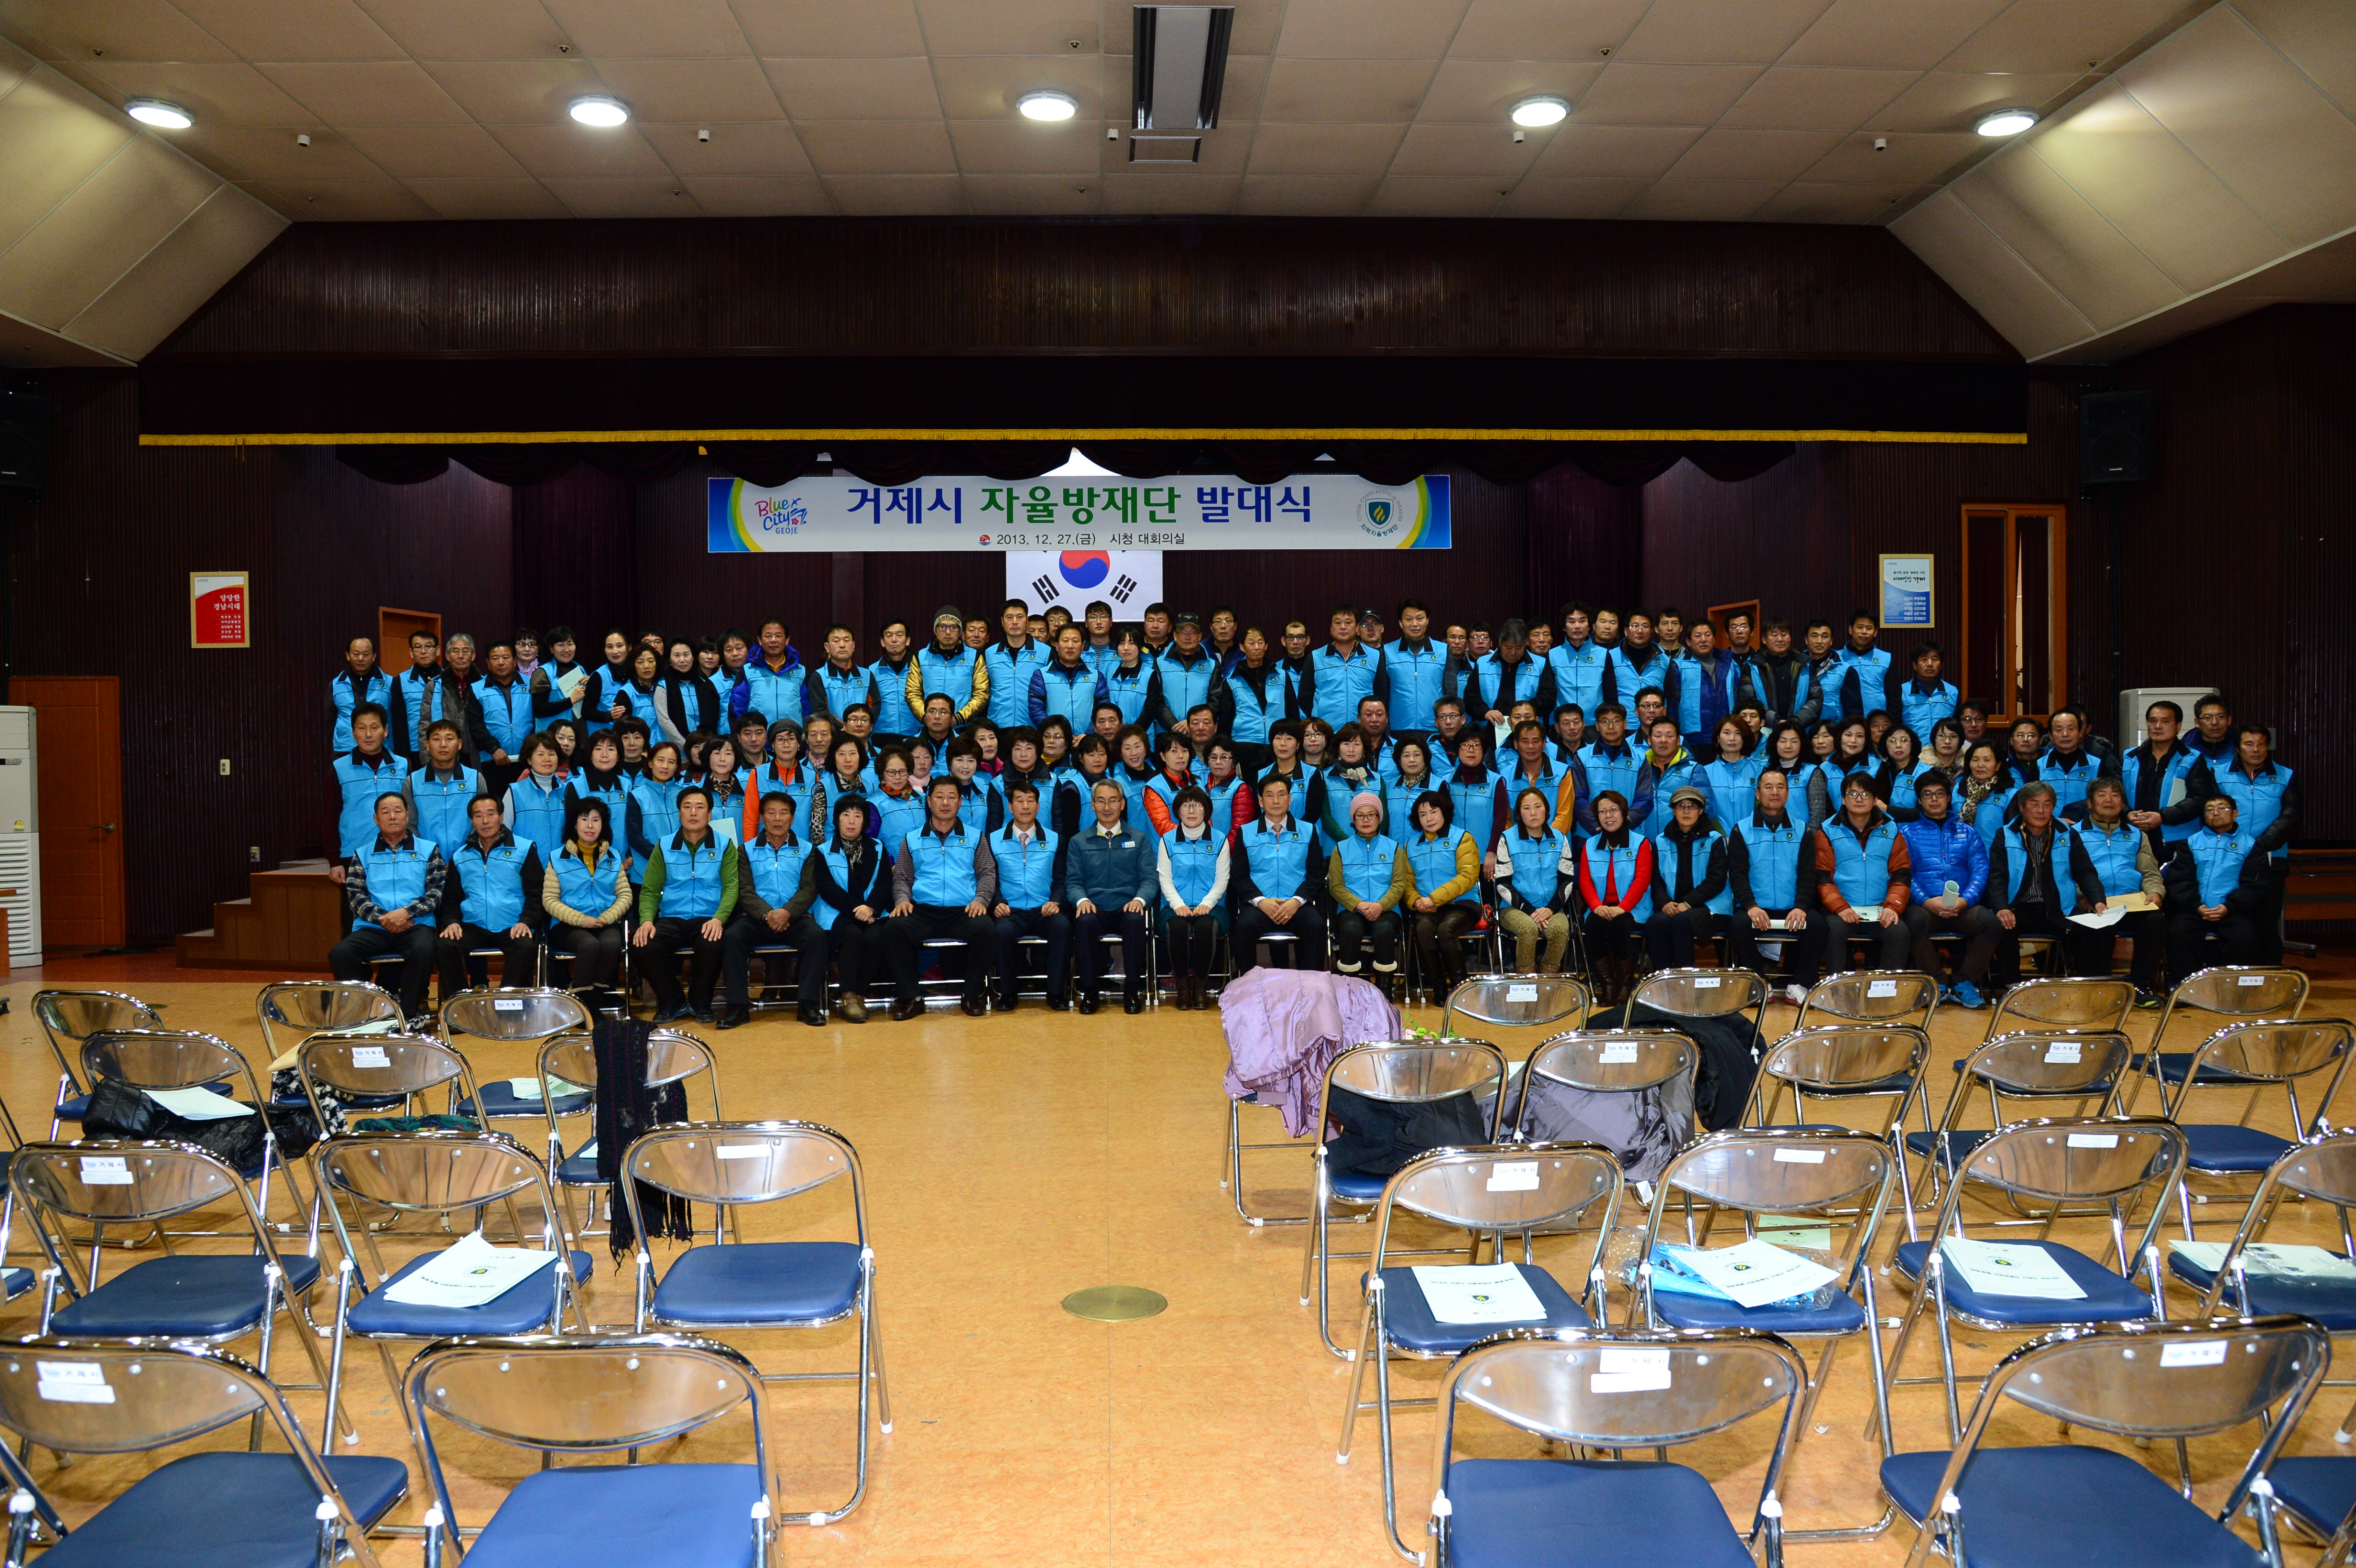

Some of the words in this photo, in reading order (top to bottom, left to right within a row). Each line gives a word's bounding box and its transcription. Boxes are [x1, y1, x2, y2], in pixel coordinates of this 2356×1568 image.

[754, 497, 790, 517] Blue
[847, 487, 961, 524] 거제시
[980, 486, 1181, 525] 자율방재단
[1197, 486, 1310, 523] 발대식
[763, 511, 789, 531] City
[997, 534, 1029, 545] 2013.
[1035, 534, 1052, 545] 12.
[1110, 533, 1133, 545] 시청
[1138, 533, 1185, 545] 대회의실
